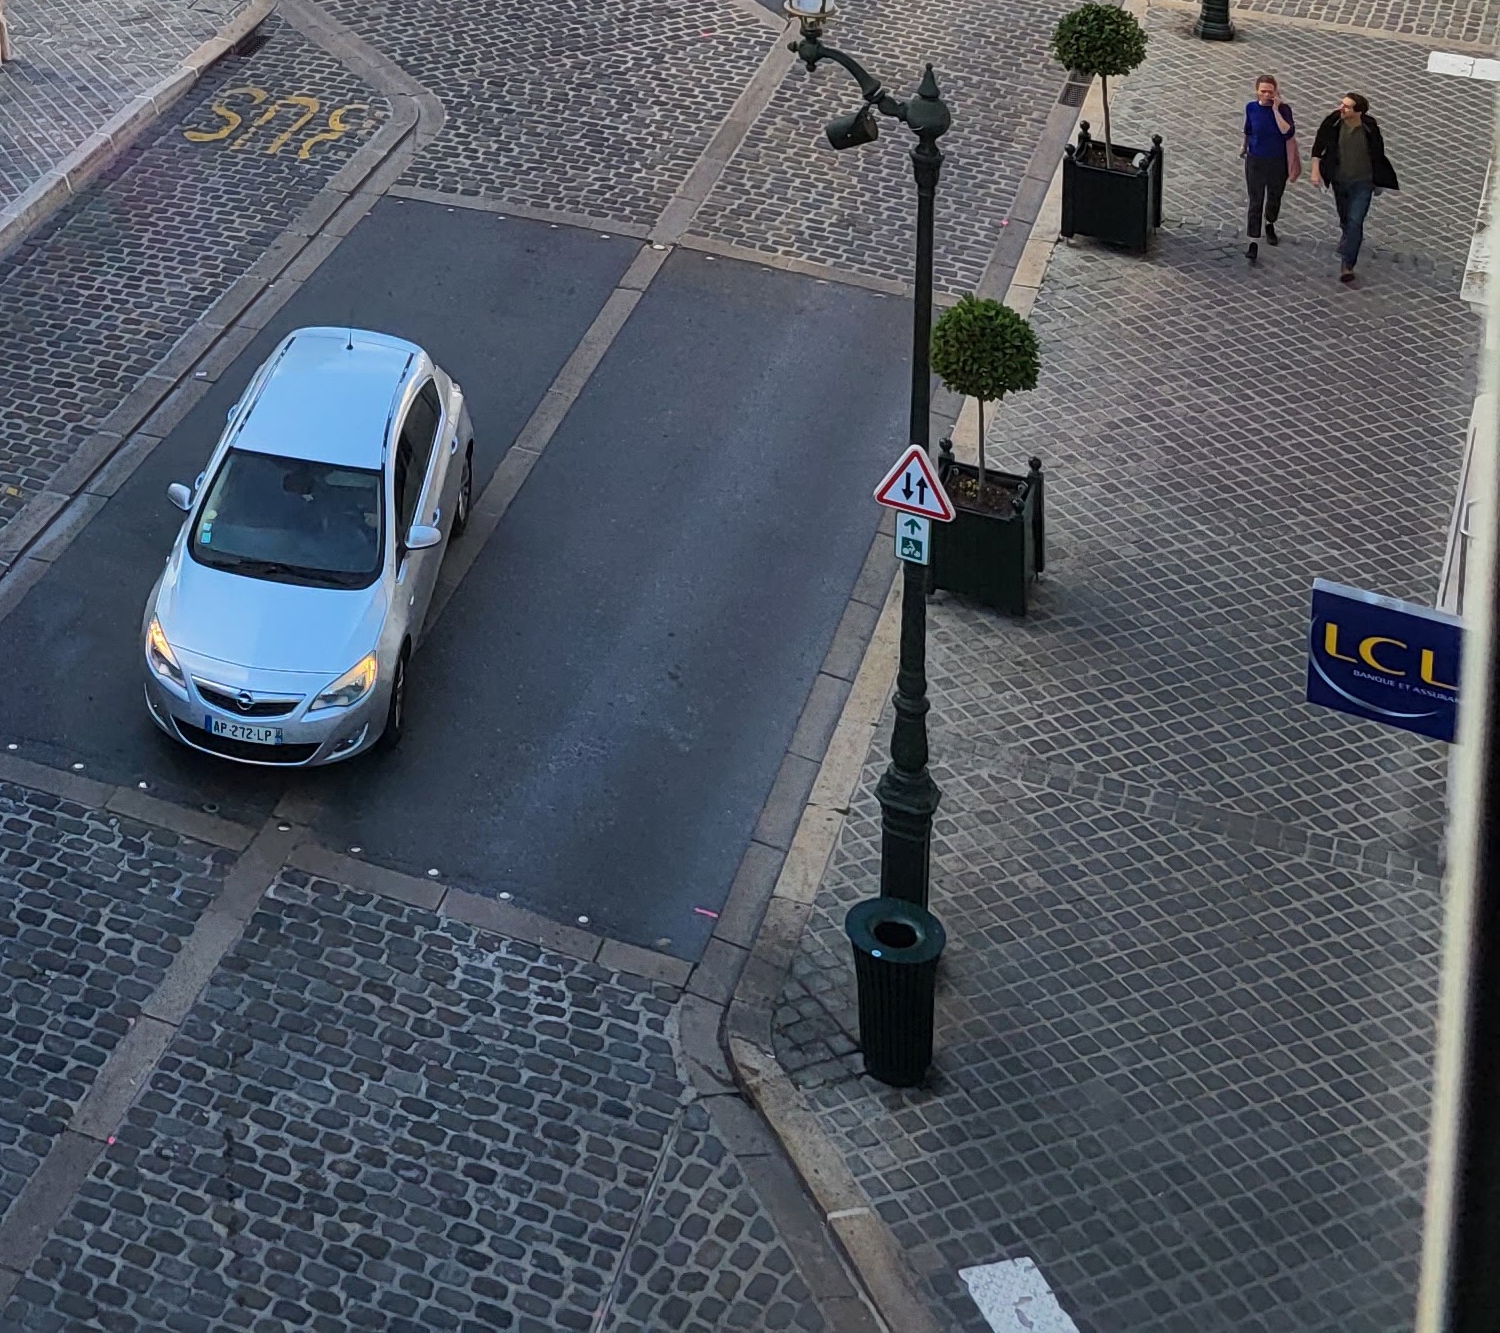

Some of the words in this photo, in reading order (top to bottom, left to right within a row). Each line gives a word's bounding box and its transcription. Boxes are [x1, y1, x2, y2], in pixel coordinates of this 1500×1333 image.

[1324, 622, 1460, 692] LCL
[1353, 669, 1395, 687] BANQUE
[1399, 683, 1411, 692] ET
